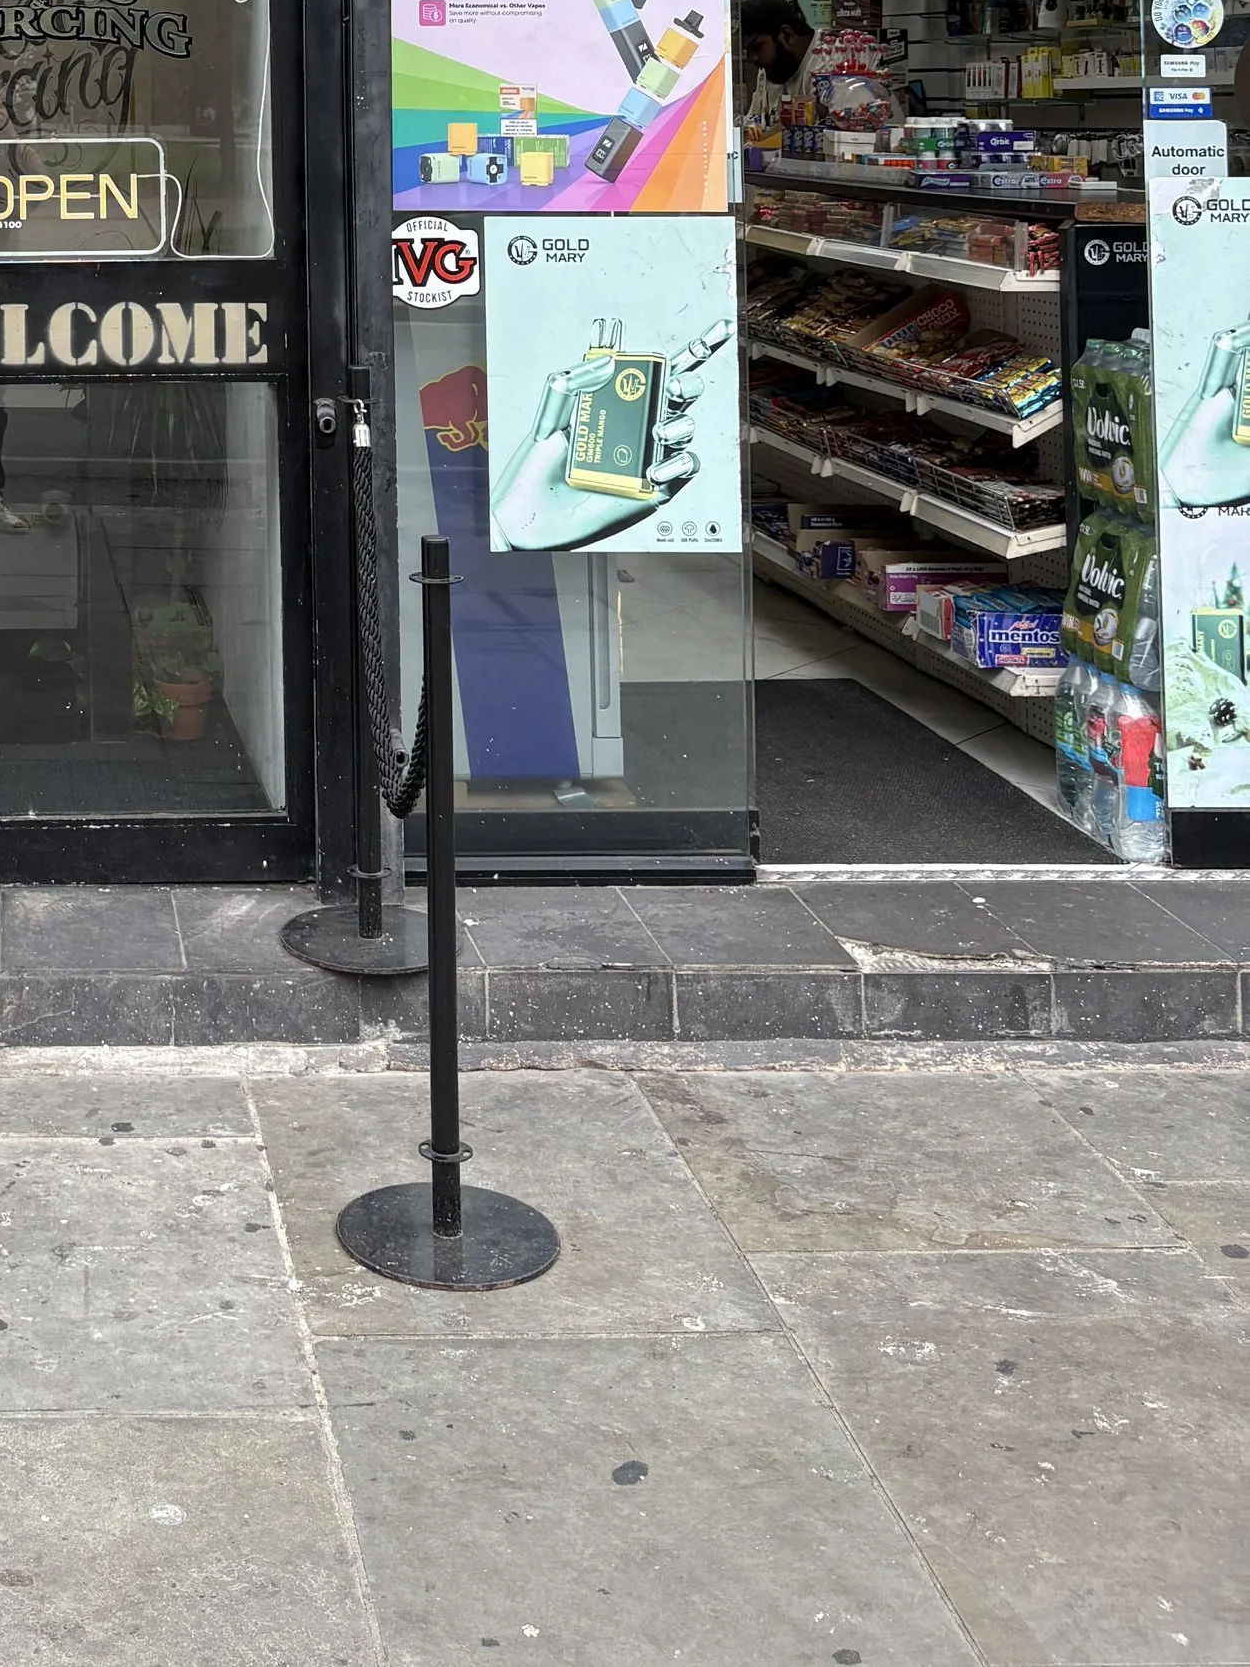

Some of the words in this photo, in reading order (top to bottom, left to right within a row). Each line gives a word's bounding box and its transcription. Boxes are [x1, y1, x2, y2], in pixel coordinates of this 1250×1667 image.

[1169, 92, 1188, 100] VISA
[1151, 145, 1225, 158] Automatic
[1172, 163, 1206, 176] door
[1210, 212, 1249, 223] MARY
[406, 220, 448, 232] OFFICIAL
[542, 238, 590, 252] GOLD
[1113, 242, 1147, 253] GOLD
[546, 252, 586, 263] MARY
[1116, 253, 1147, 263] MARY
[407, 290, 452, 303] STOCKIST
[916, 298, 955, 327] CHOCO
[580, 393, 593, 423] MAR
[598, 409, 607, 437] MANGO
[1086, 406, 1131, 446] Volvic
[575, 425, 589, 462] GOLD
[593, 437, 604, 464] TRIPLE
[1081, 553, 1124, 599] Volvic
[989, 629, 1062, 645] mentos
